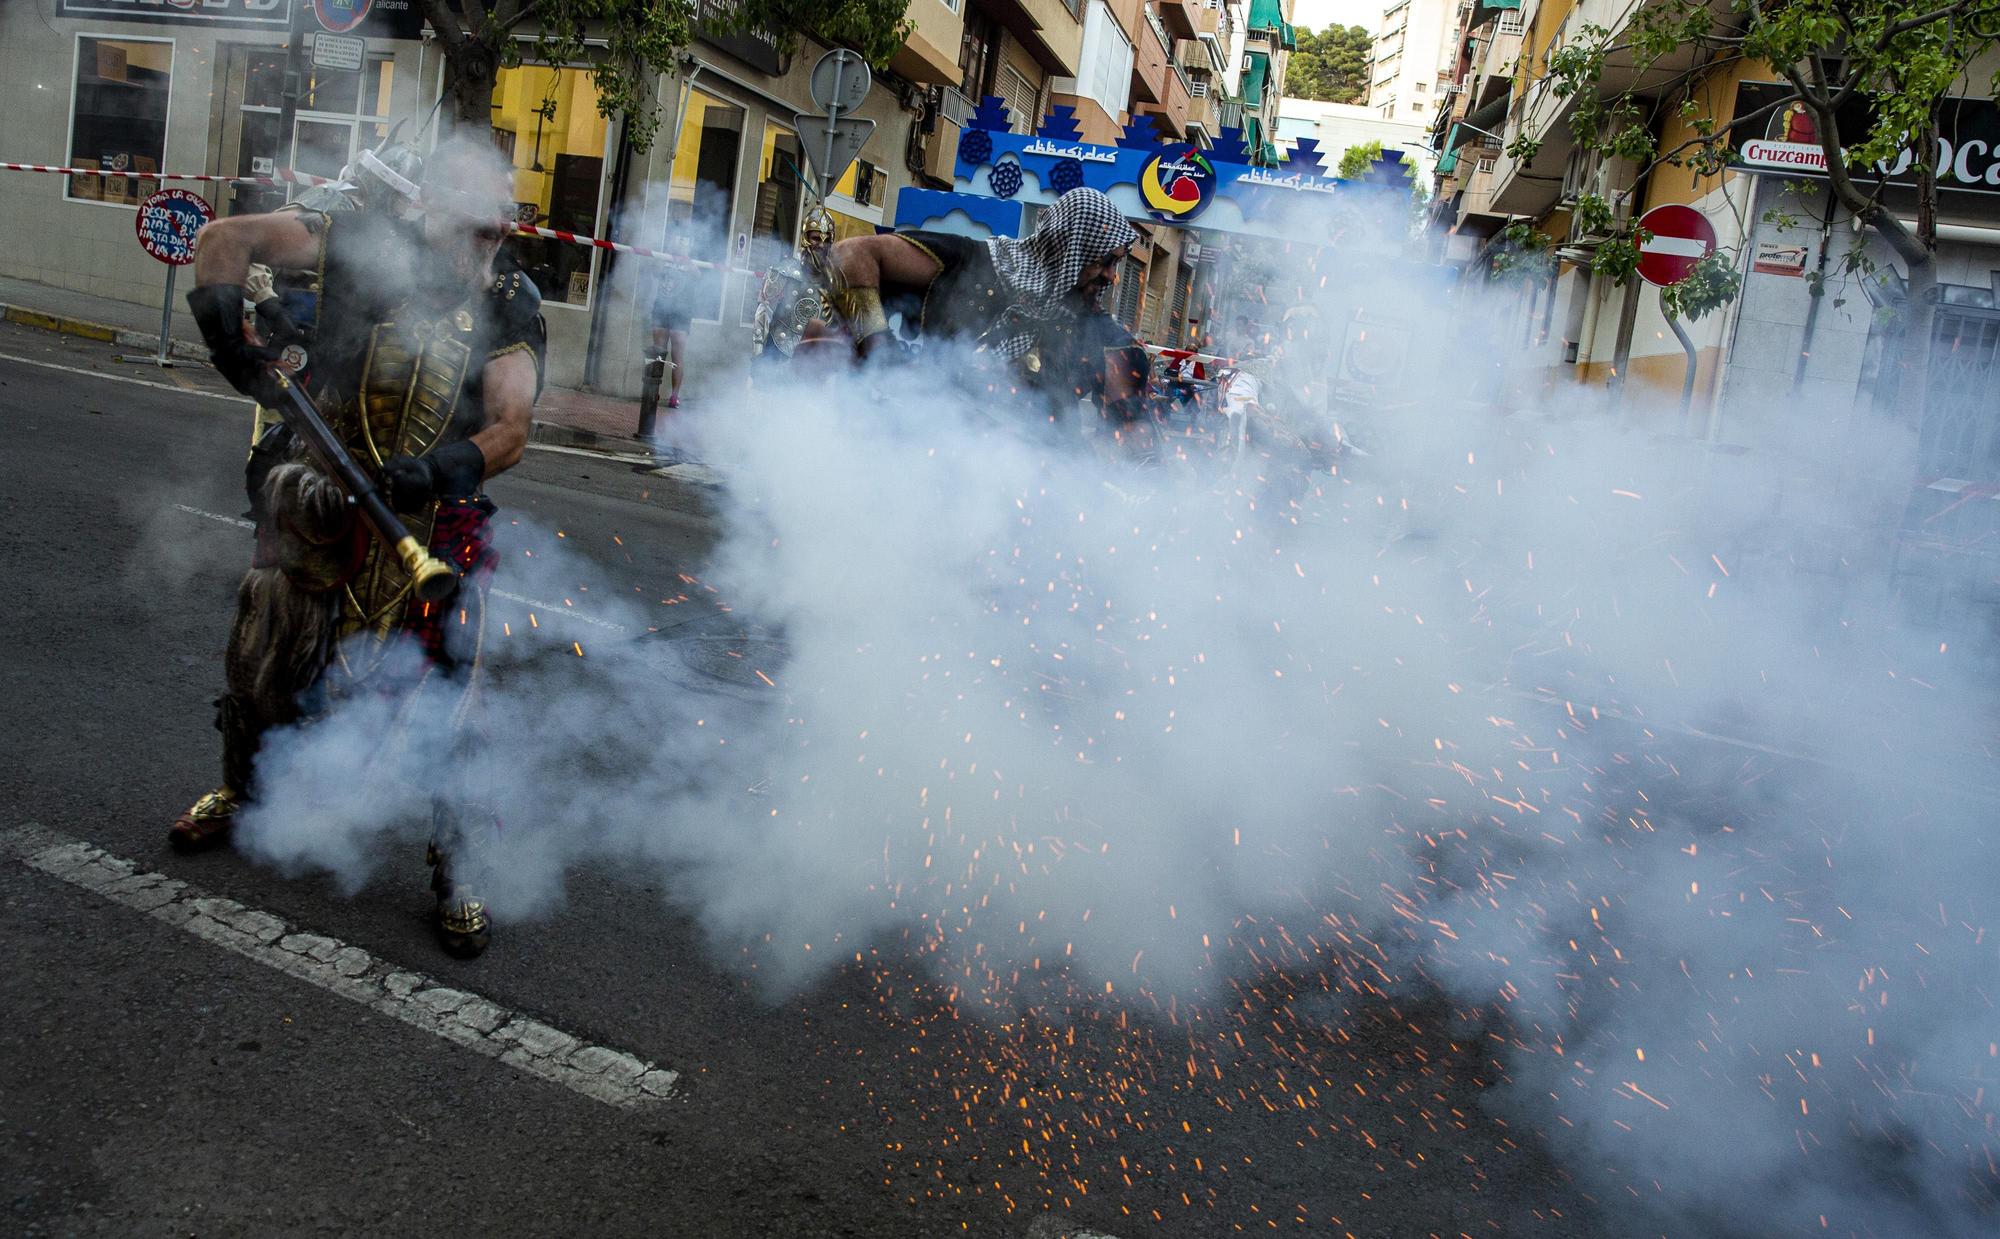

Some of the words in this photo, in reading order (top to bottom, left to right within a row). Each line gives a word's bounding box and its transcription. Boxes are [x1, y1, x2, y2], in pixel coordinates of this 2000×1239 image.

[375, 0, 409, 10] alicante
[1022, 139, 1119, 163] abbasidas
[1748, 144, 1827, 169] Cruzcamp
[1237, 168, 1338, 193] abbasidas
[141, 206, 172, 221] DESDE
